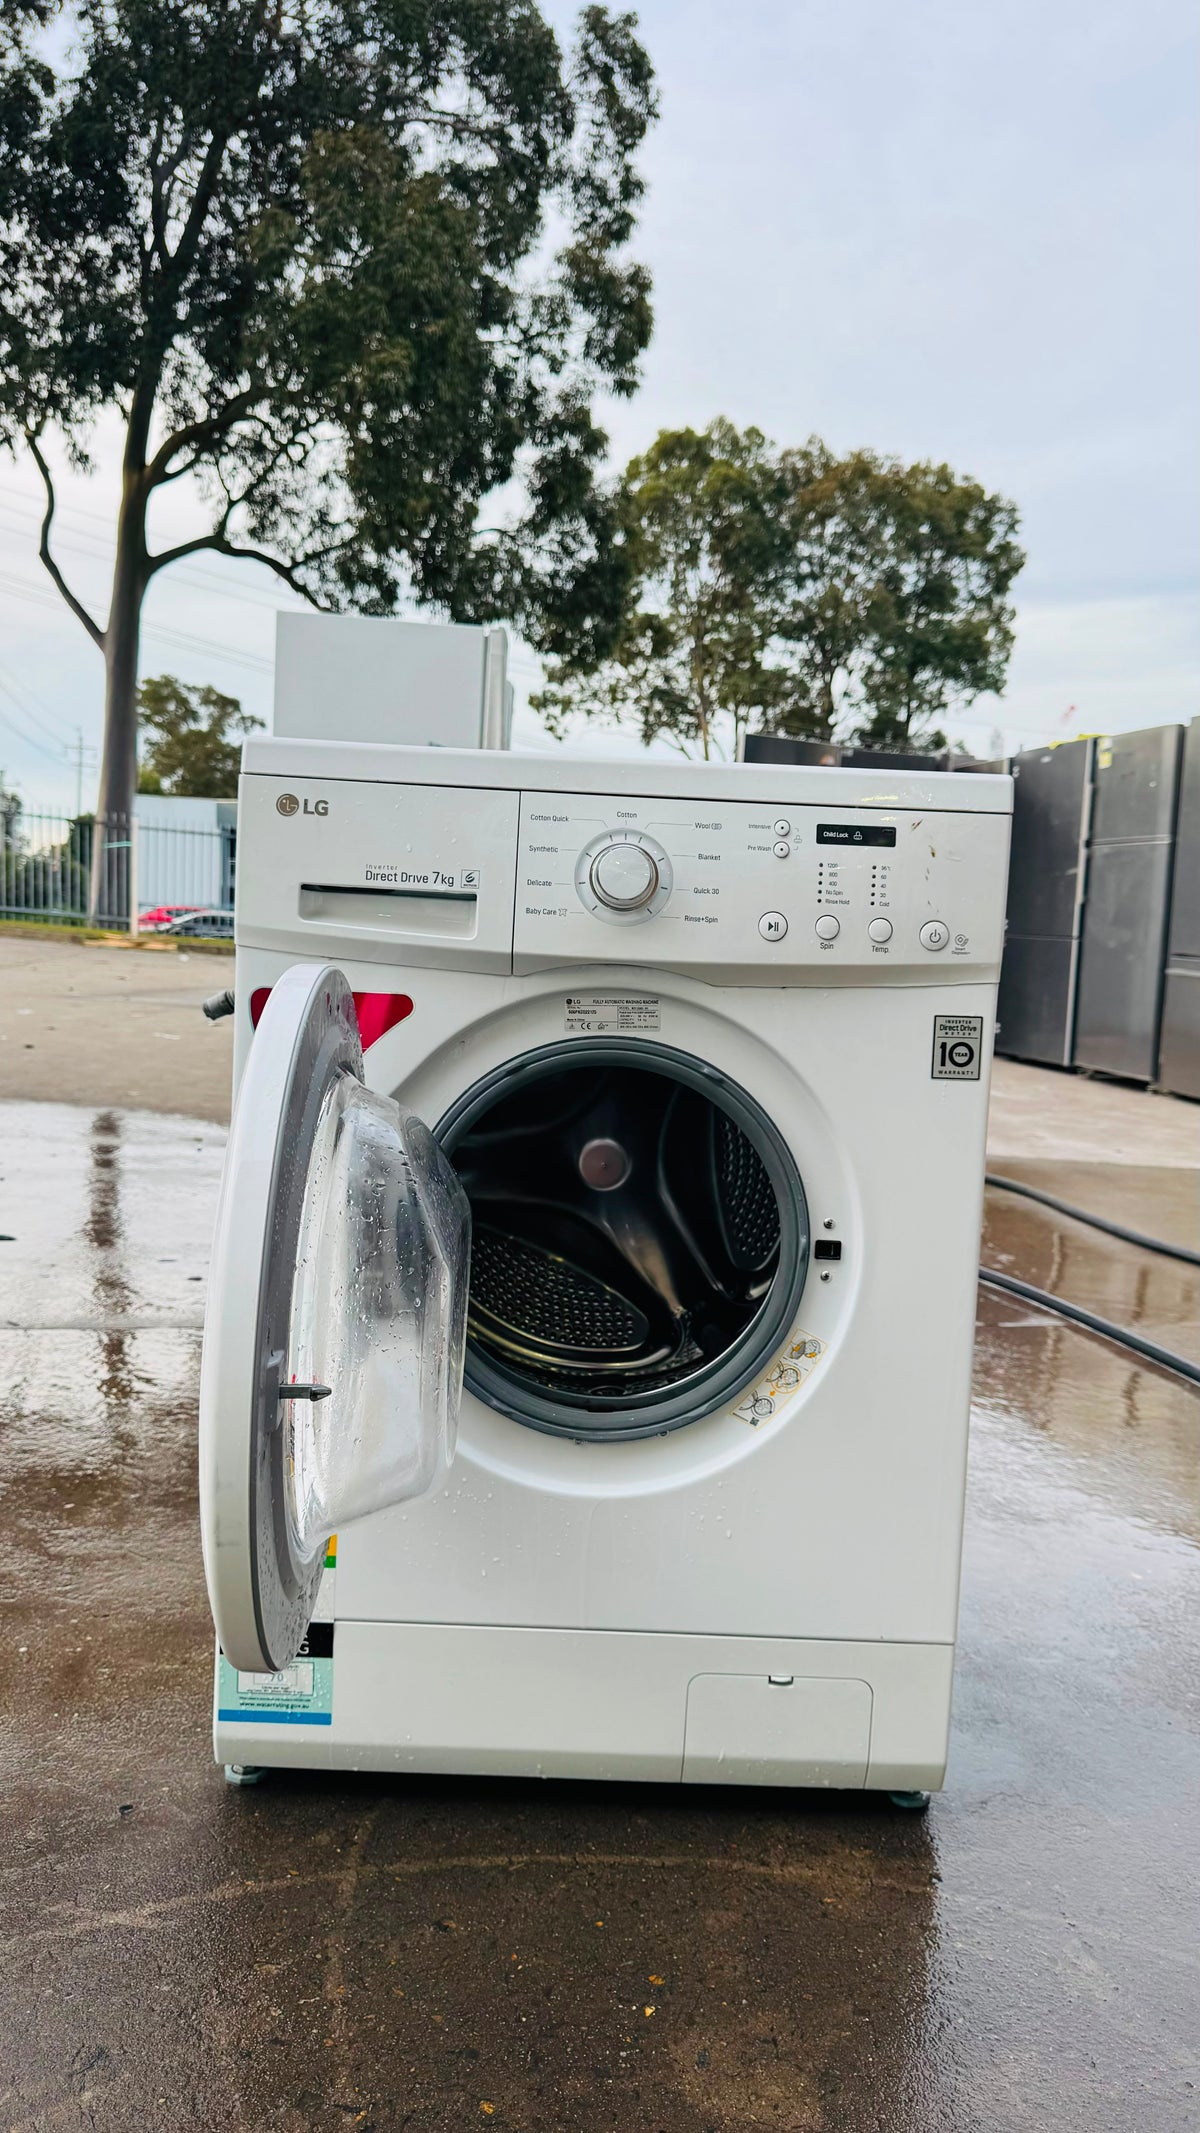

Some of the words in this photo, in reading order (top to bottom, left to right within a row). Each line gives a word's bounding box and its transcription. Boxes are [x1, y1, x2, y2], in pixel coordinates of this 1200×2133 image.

[694, 822, 711, 830] Wool
[529, 845, 559, 853] Synthetic
[697, 853, 721, 861] Blanket
[365, 863, 399, 871] Inverter
[365, 870, 399, 882] Direct
[400, 871, 429, 884] Drive
[526, 879, 553, 887] Delicate
[693, 887, 711, 895] Quick
[525, 908, 541, 917] Baby
[542, 908, 557, 916] Care
[684, 915, 719, 924] Rinse+Spin
[820, 942, 834, 950] Spin
[940, 1041, 975, 1067] 10
